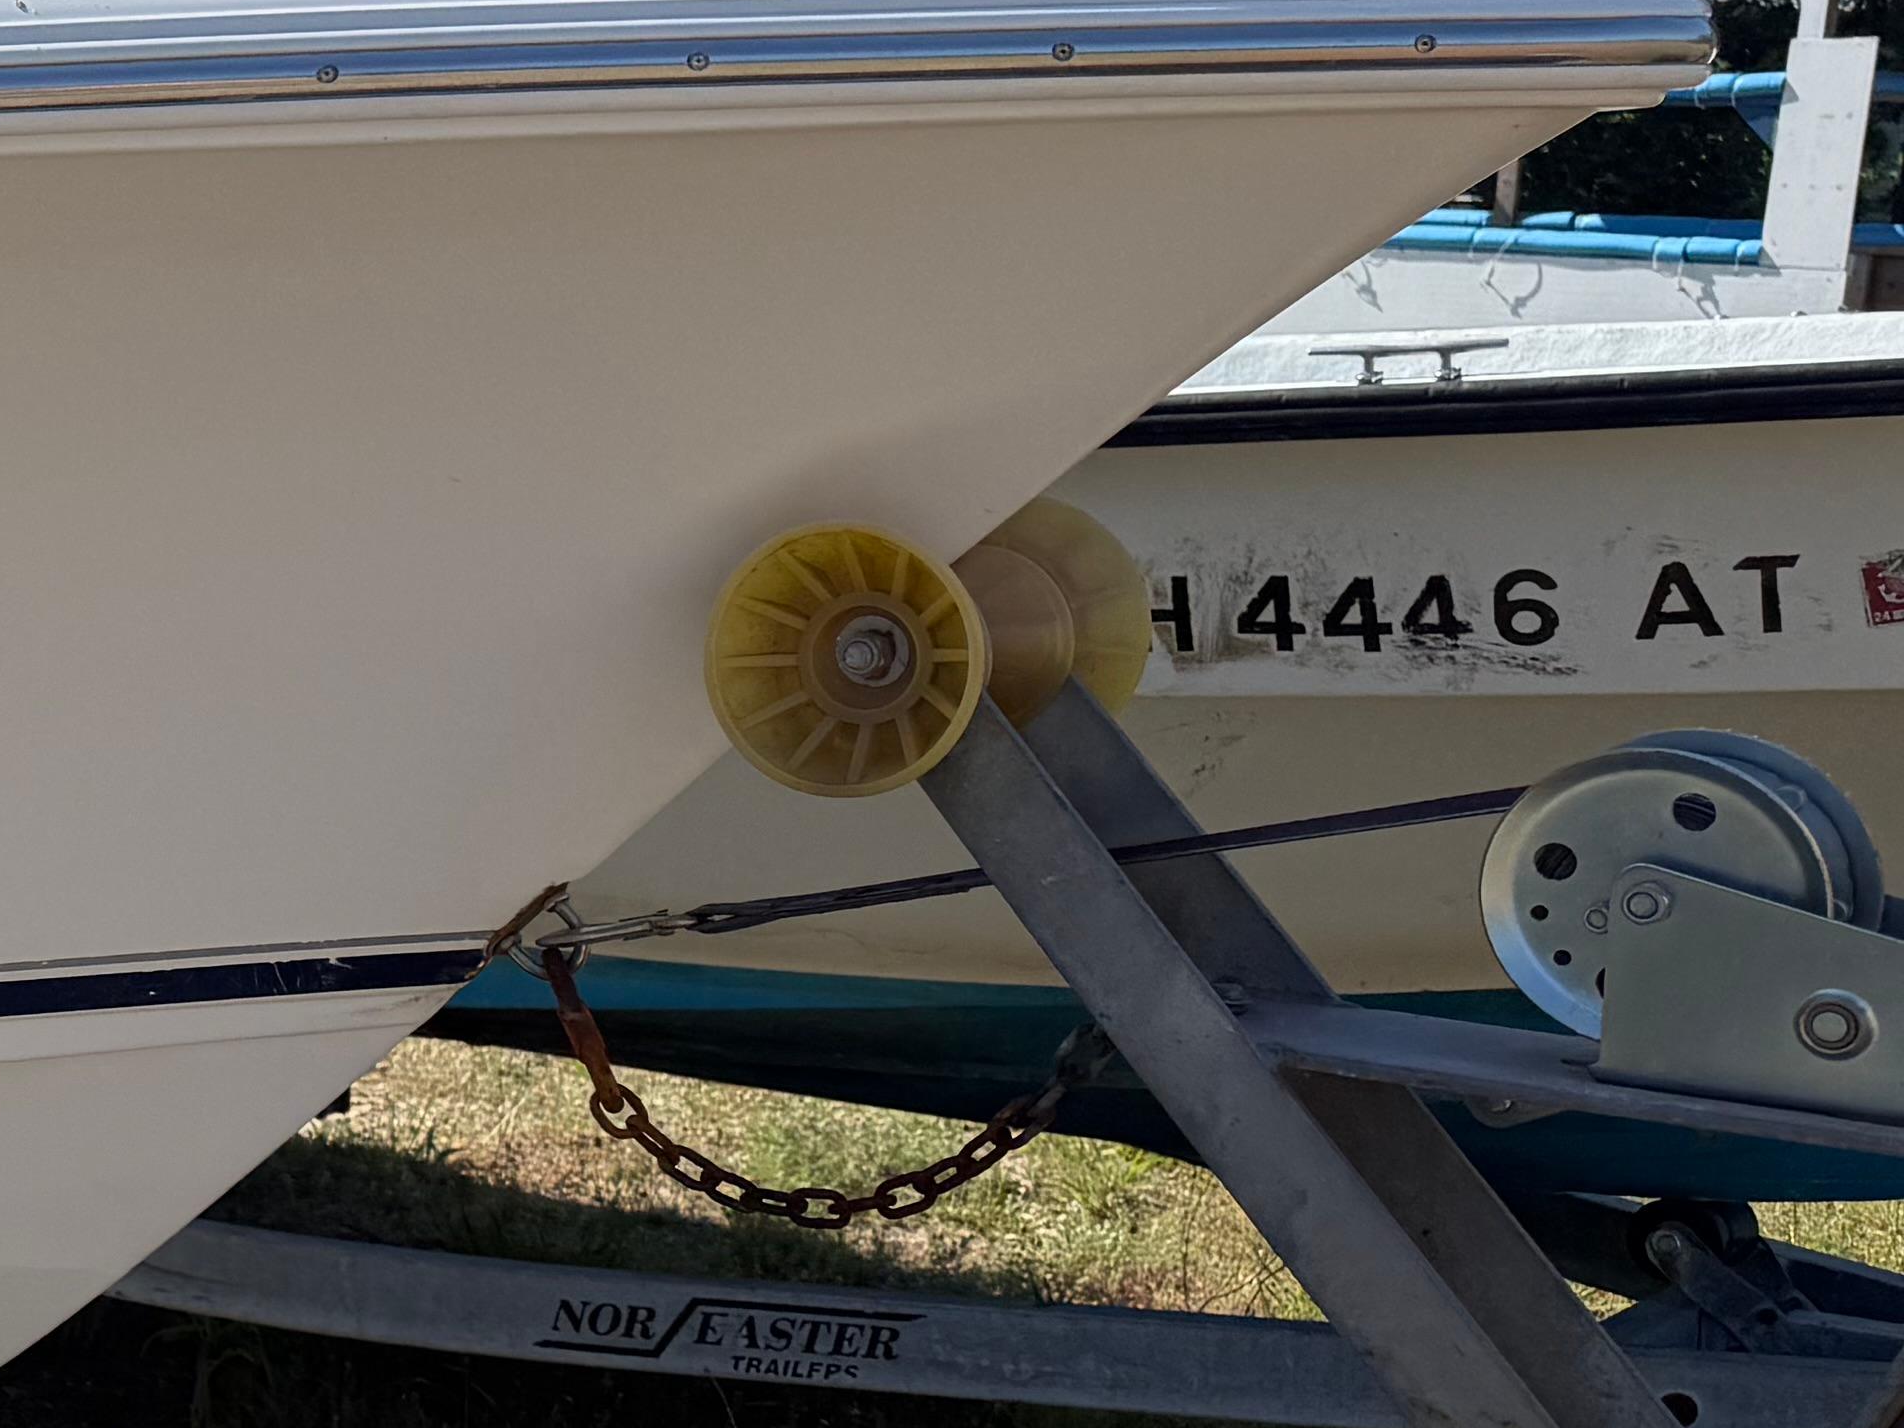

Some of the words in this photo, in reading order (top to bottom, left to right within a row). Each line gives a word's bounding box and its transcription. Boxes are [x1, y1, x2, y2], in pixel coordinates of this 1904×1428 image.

[1149, 575, 1194, 652] H
[1237, 568, 1560, 652] 4446
[1635, 554, 1800, 640] AT
